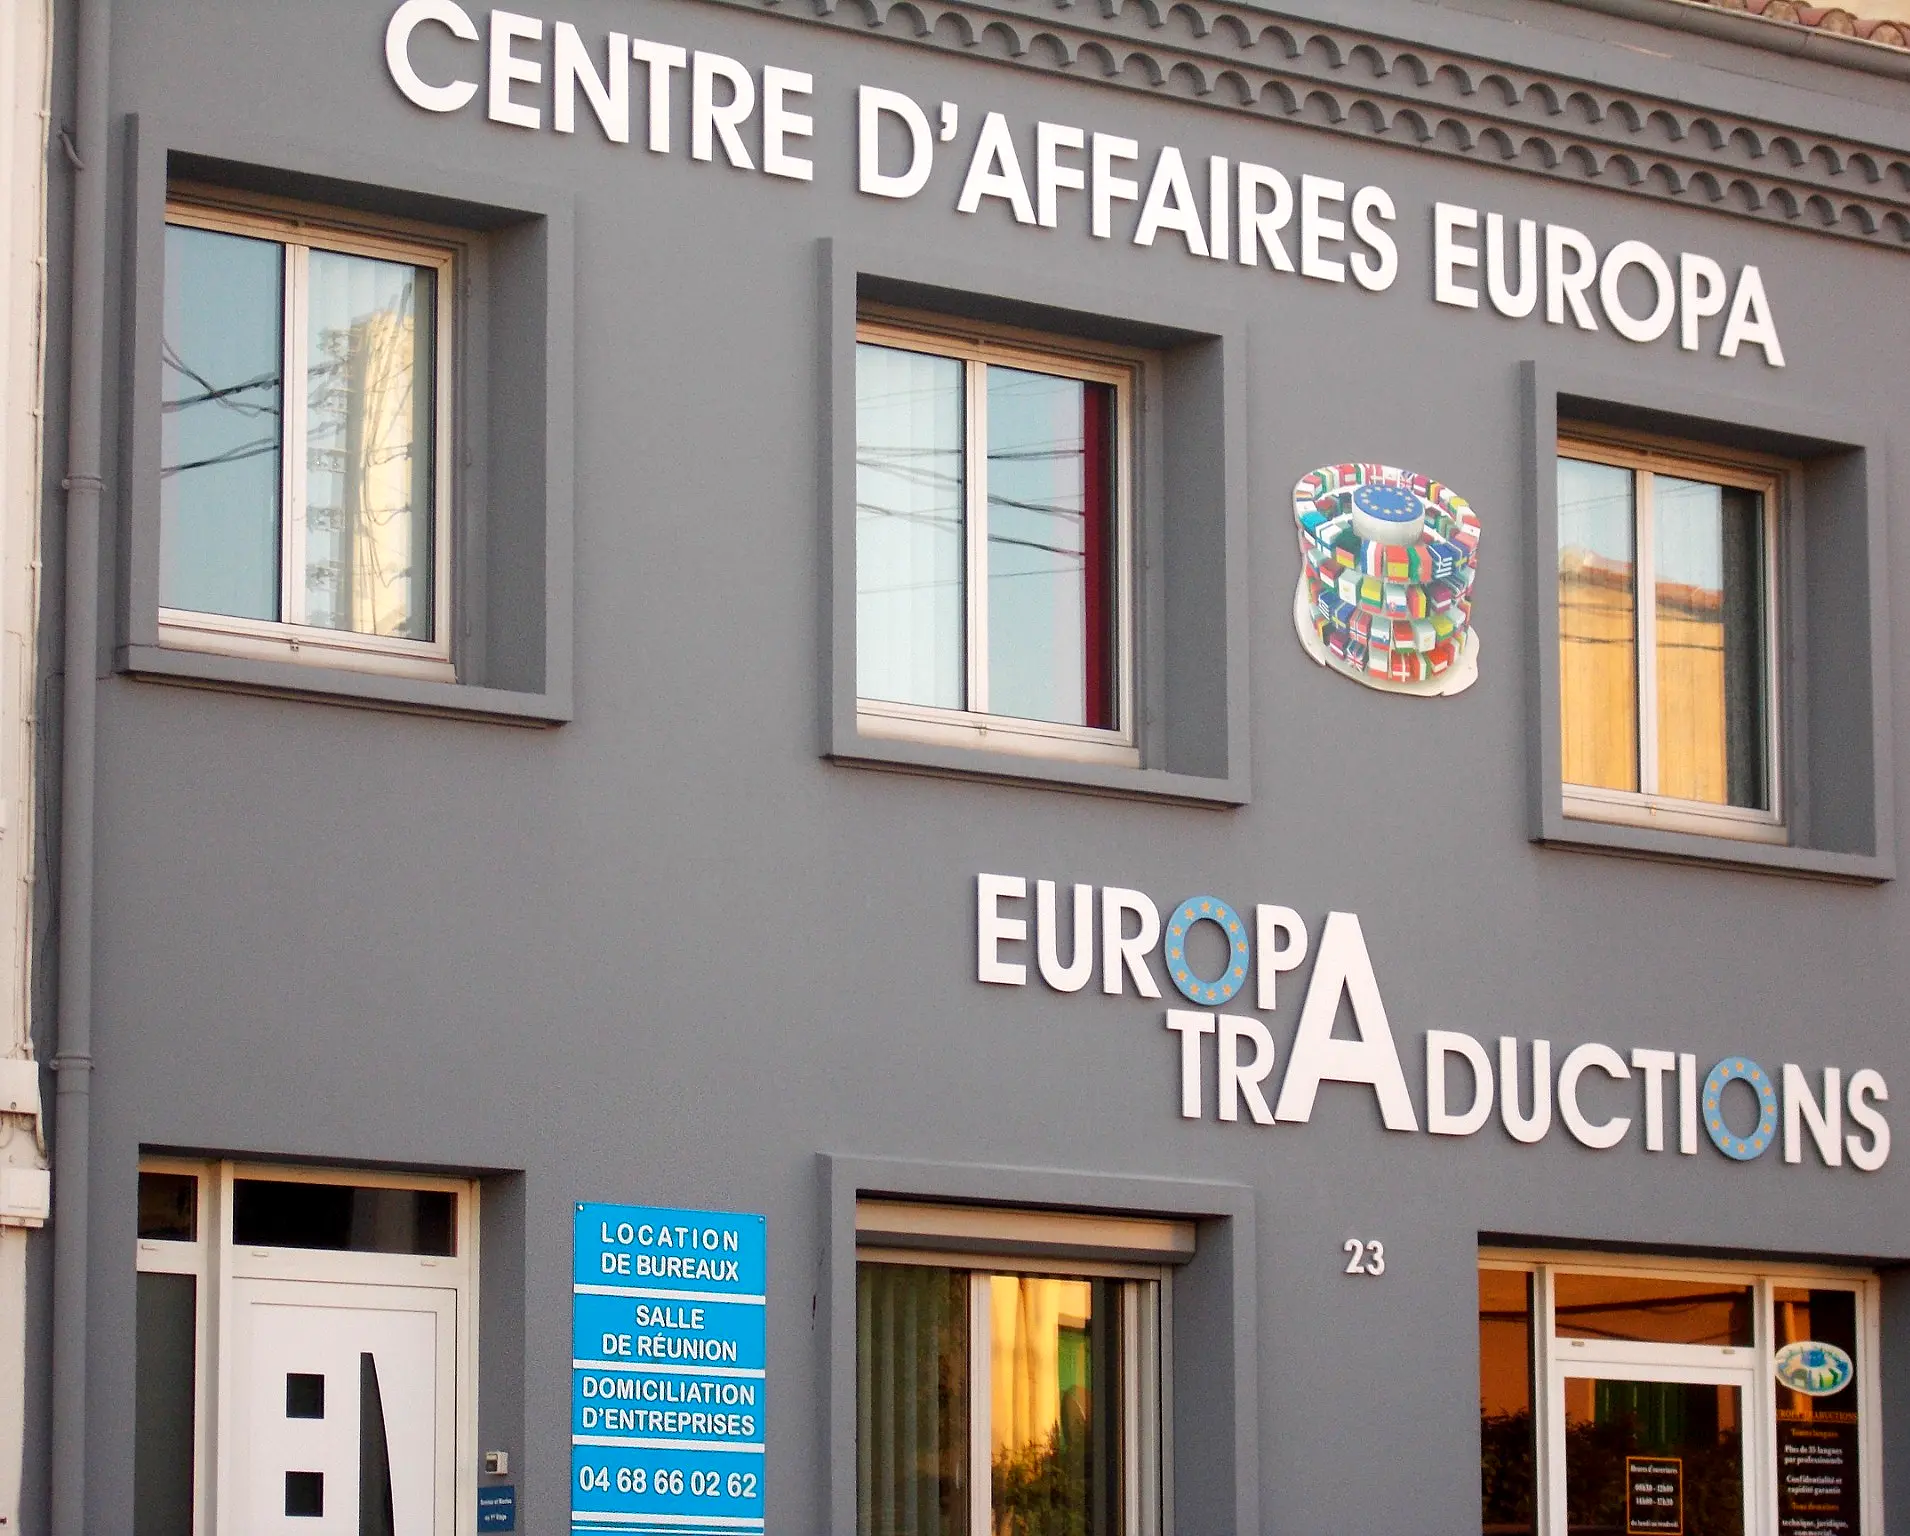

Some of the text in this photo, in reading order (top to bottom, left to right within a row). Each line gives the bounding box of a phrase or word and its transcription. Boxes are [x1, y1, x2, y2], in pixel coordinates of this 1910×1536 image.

[384, 0, 1787, 367] CENTRE D'AFFAIRES EUROPA
[600, 1221, 741, 1252] LOCATION
[600, 1252, 740, 1282] DE BUREAUX
[1343, 1238, 1386, 1276] 23
[635, 1304, 706, 1330] SALLE
[601, 1332, 738, 1362] DE RÉUNION
[581, 1375, 756, 1406] DOMICILIATION
[581, 1407, 756, 1437] D'ENTREPRISES
[578, 1465, 758, 1499] 04 68 66 02 62
